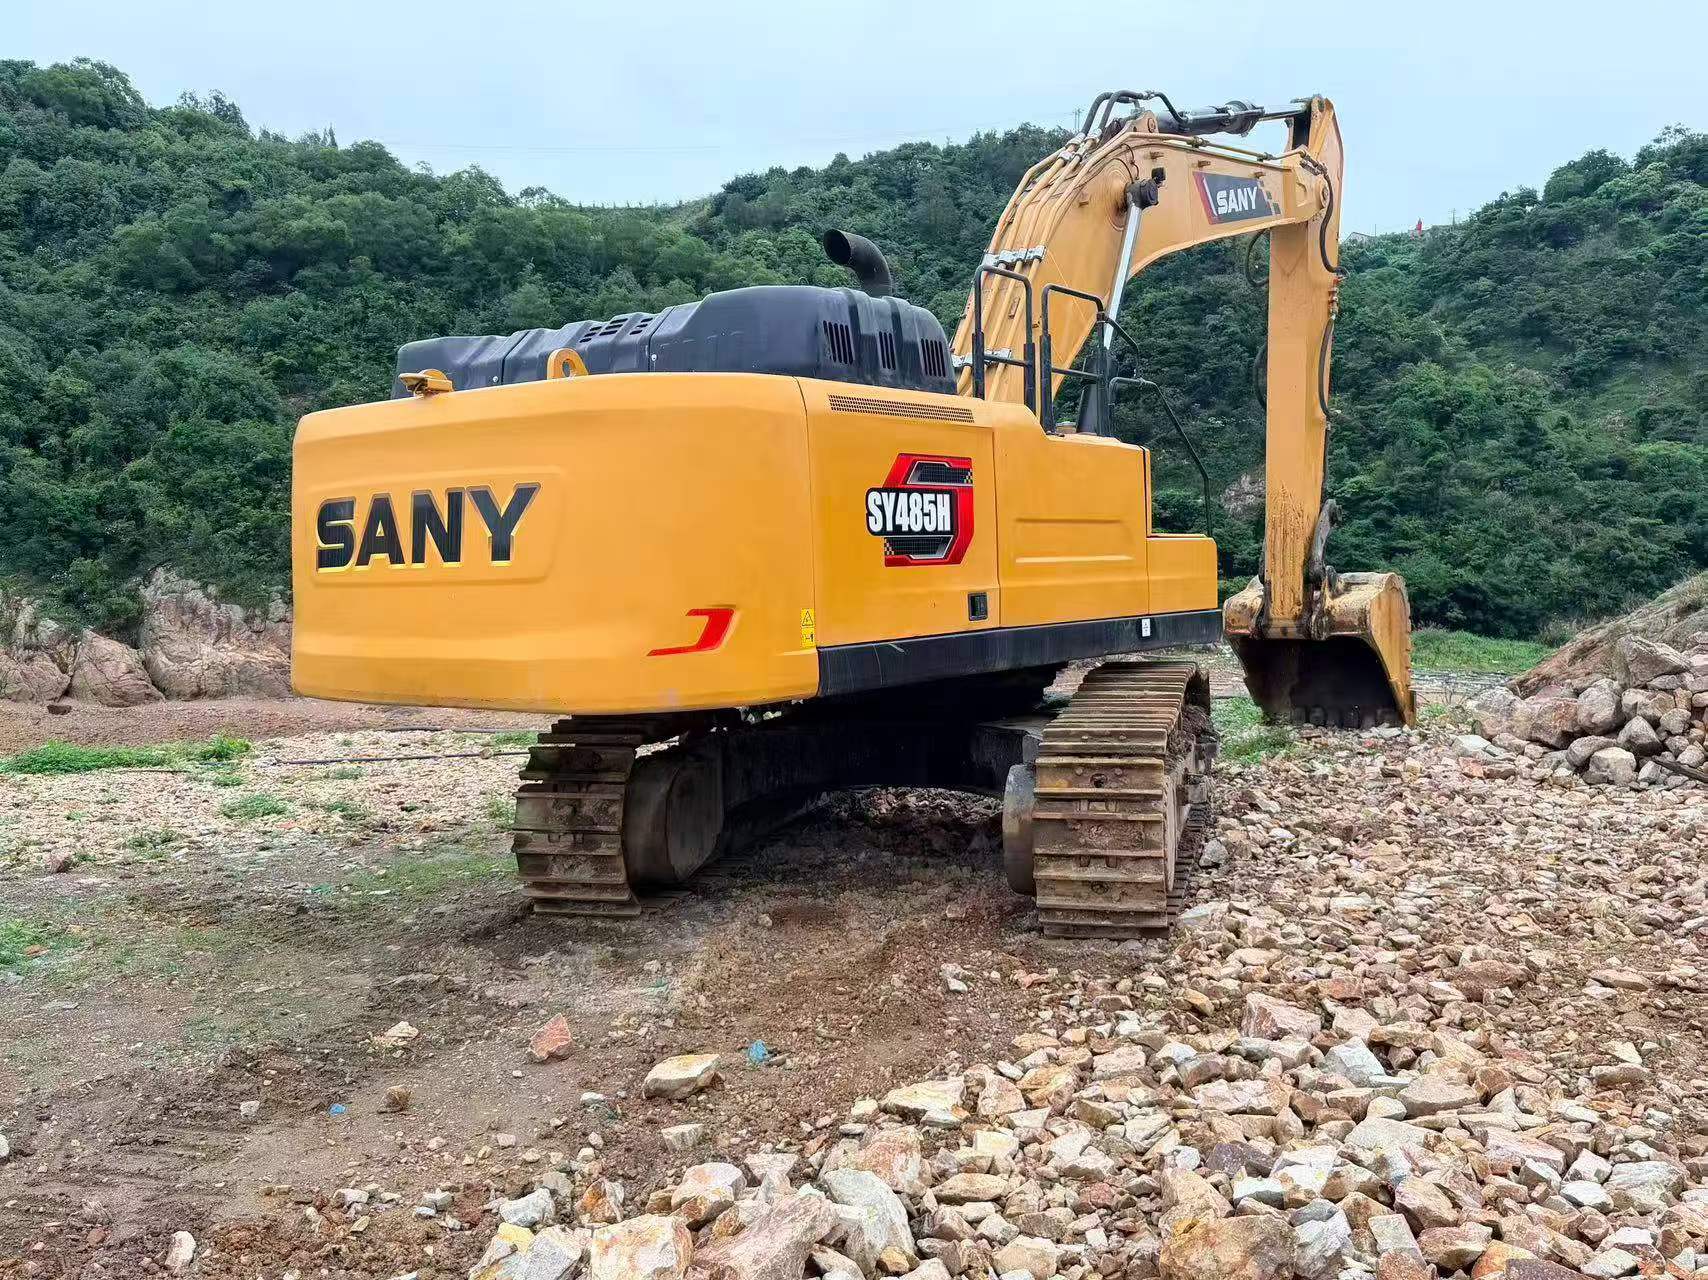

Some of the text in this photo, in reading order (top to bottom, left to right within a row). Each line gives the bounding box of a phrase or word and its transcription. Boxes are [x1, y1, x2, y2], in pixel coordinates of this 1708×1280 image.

[1217, 187, 1258, 214] SANY
[316, 482, 541, 573] SANY
[867, 491, 951, 532] SY485H
